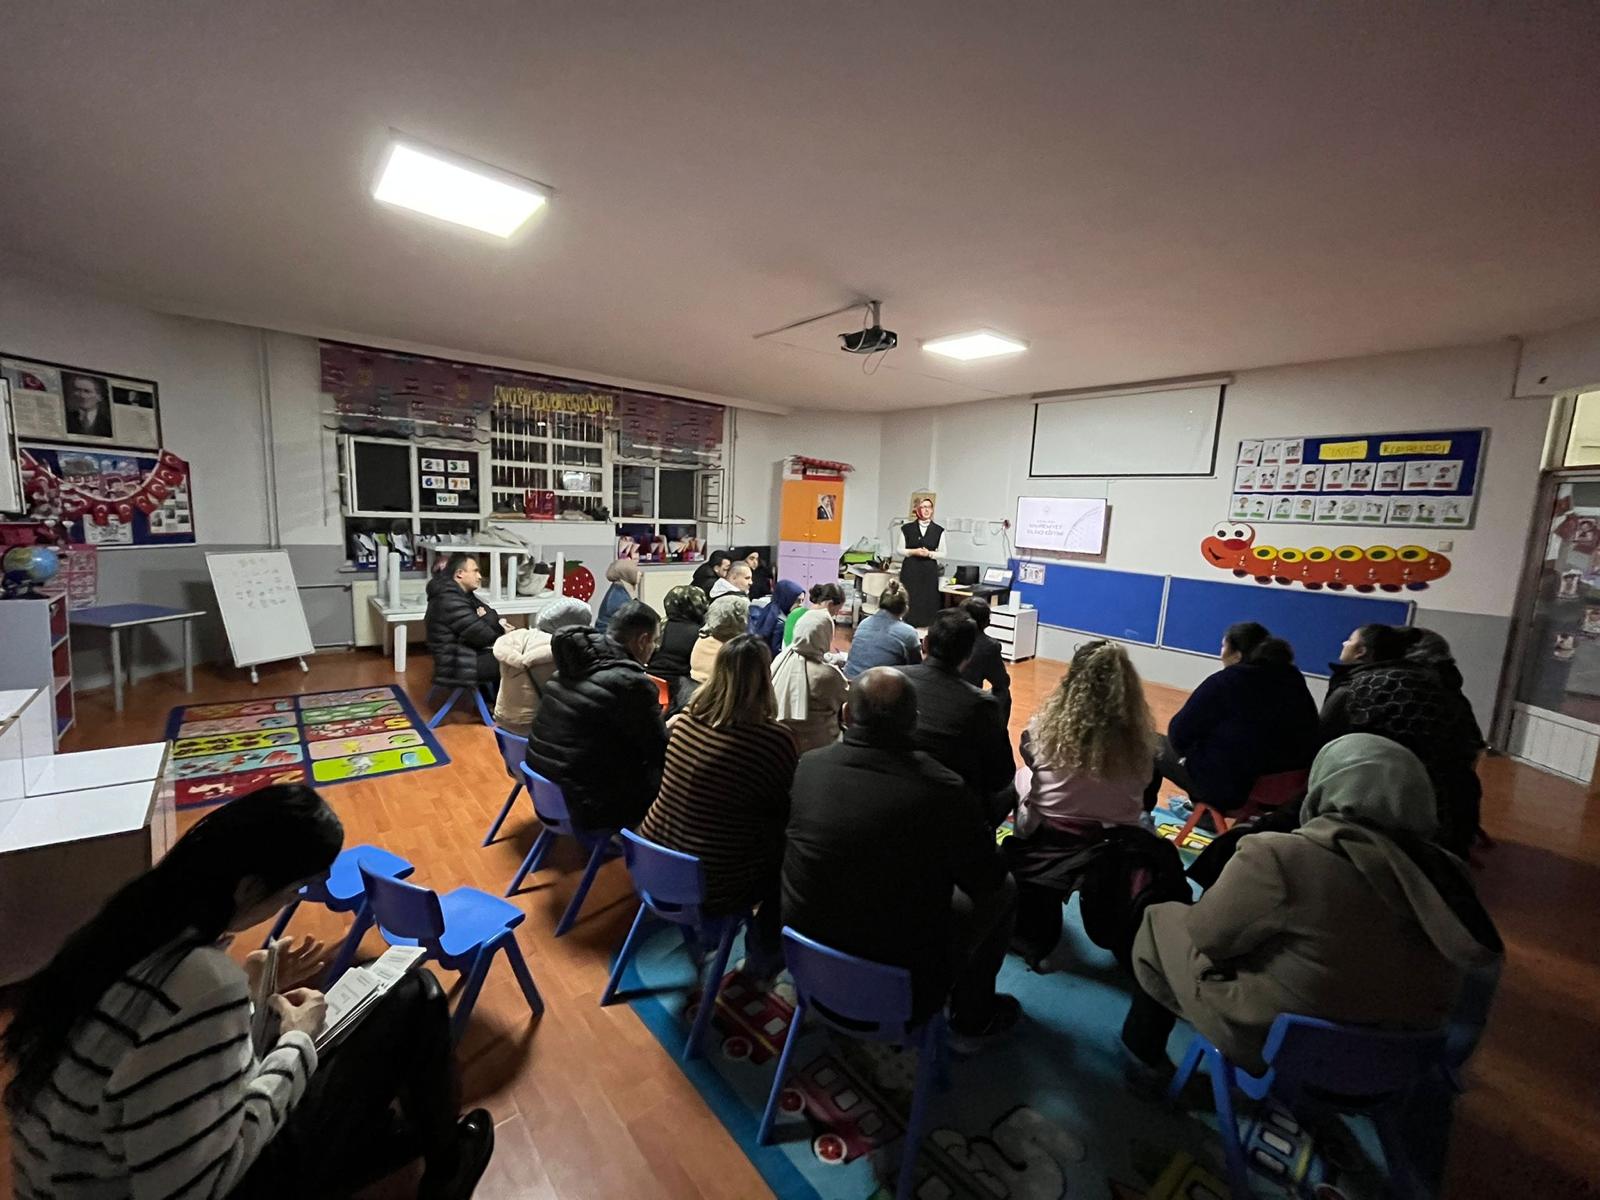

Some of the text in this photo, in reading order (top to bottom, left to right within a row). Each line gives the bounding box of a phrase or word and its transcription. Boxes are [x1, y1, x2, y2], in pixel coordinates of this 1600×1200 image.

[424, 460, 433, 470] 2
[450, 461, 458, 471] 3
[425, 477, 433, 487] 6
[451, 479, 458, 488] 7
